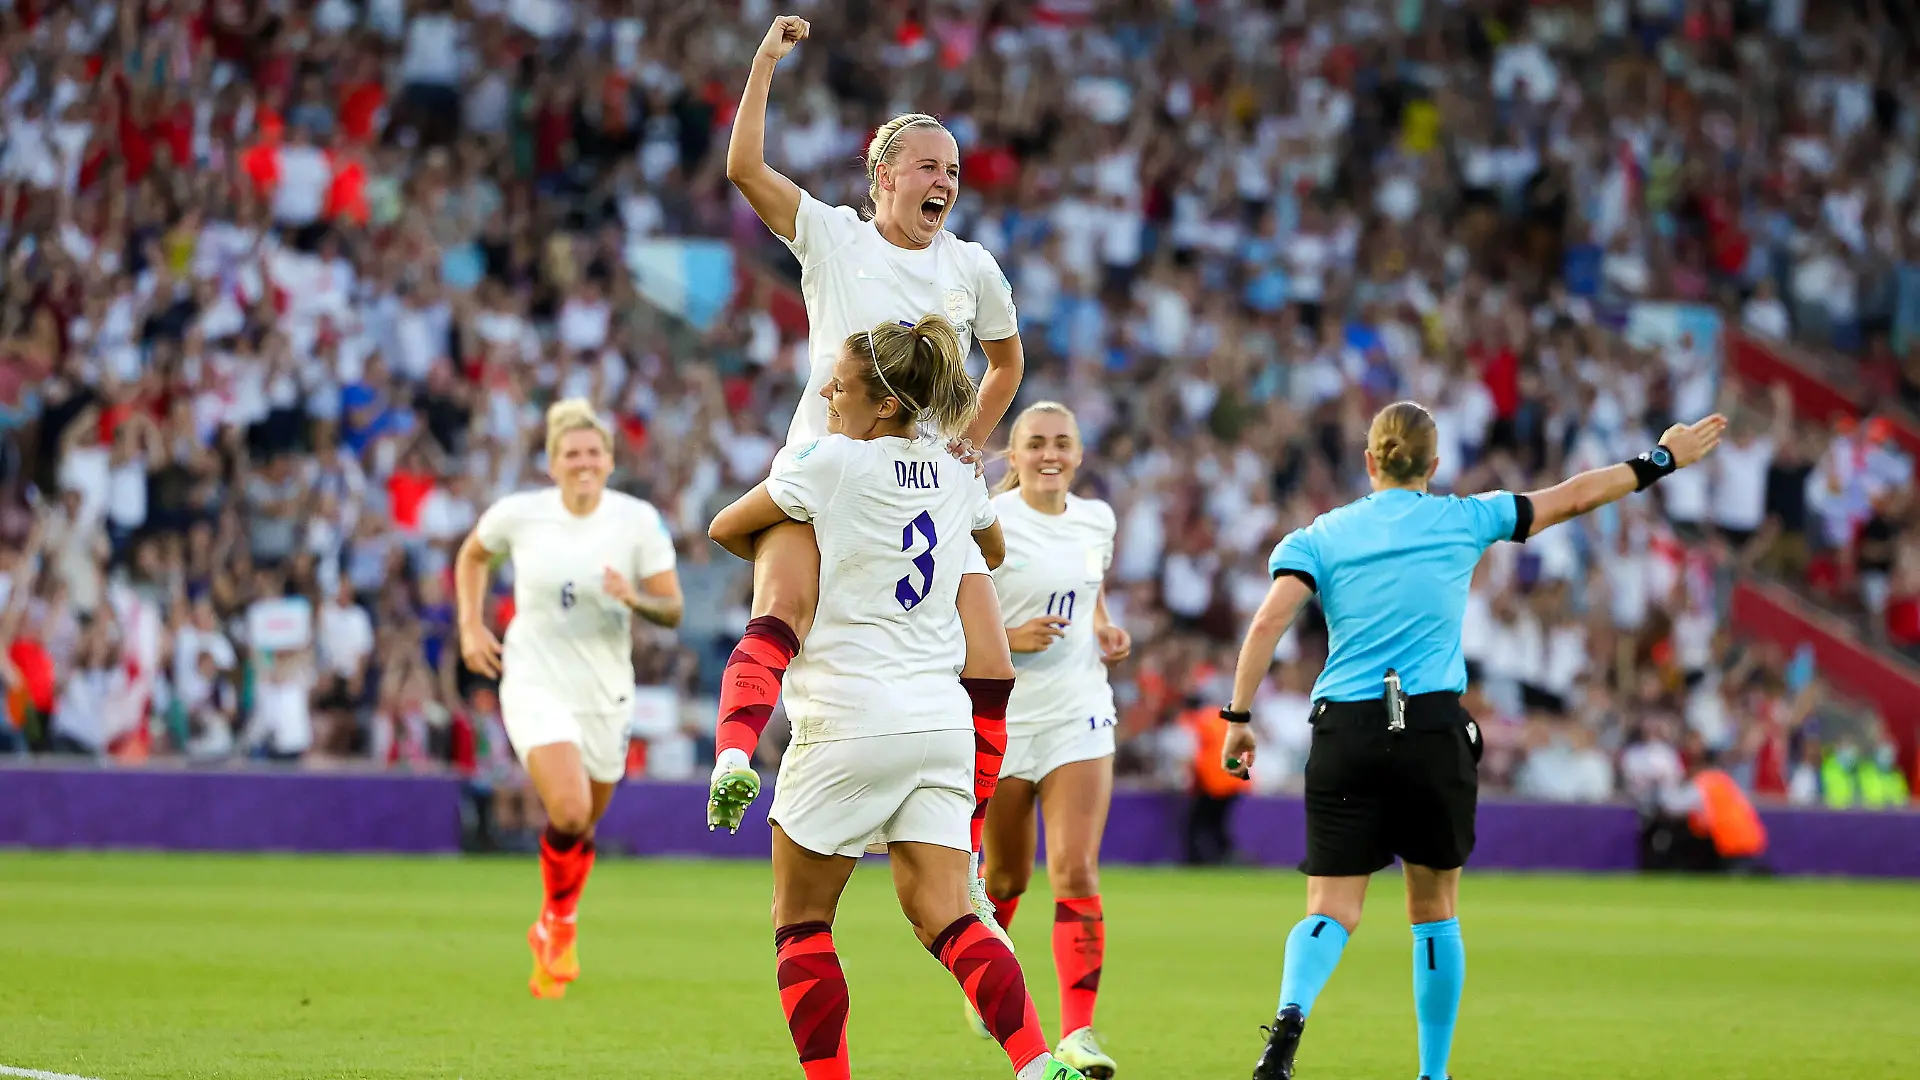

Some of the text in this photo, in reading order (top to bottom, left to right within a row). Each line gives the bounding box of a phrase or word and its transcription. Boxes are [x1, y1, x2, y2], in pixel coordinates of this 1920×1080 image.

[894, 460, 940, 489] DALY
[895, 509, 938, 612] 3
[561, 581, 576, 609] 6
[1046, 590, 1076, 628] 10
